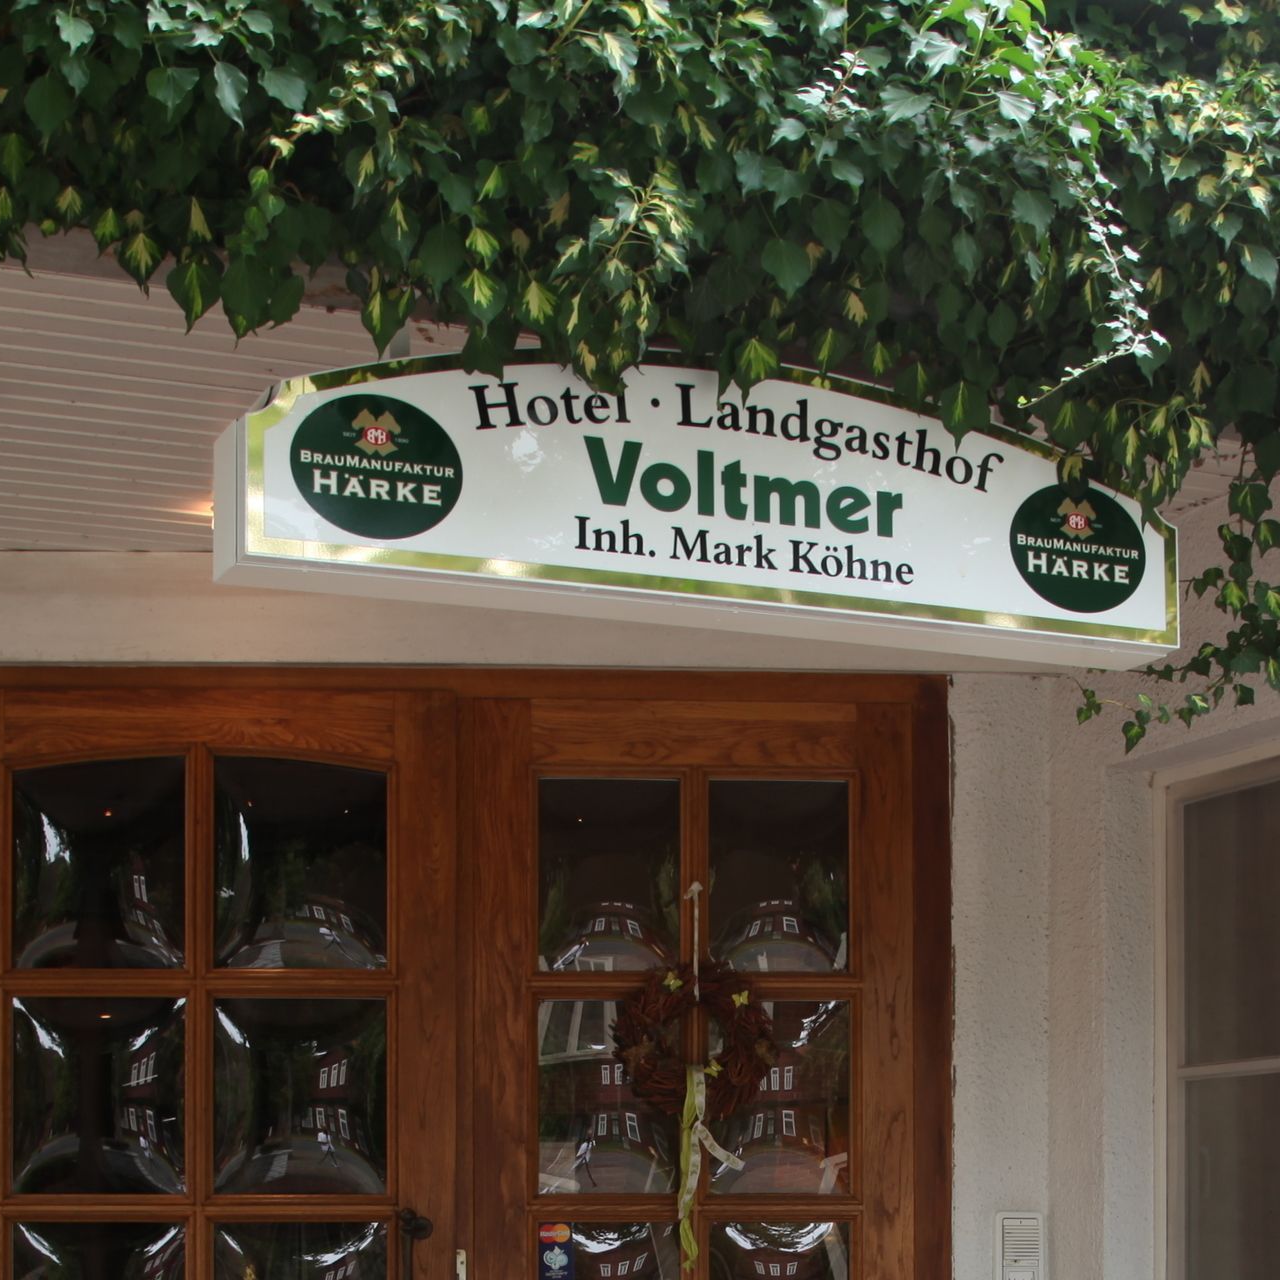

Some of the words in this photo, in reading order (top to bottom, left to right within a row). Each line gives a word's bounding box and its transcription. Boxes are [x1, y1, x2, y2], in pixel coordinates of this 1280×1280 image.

[468, 382, 631, 429] Hotel
[675, 384, 1004, 492] Landgasthof
[312, 469, 442, 506] HÄRKE
[583, 435, 903, 538] Voltmer
[574, 515, 656, 557] Inh.
[670, 526, 778, 570] Mark
[789, 539, 915, 585] Köhne
[1027, 551, 1130, 584] HÄRKE
